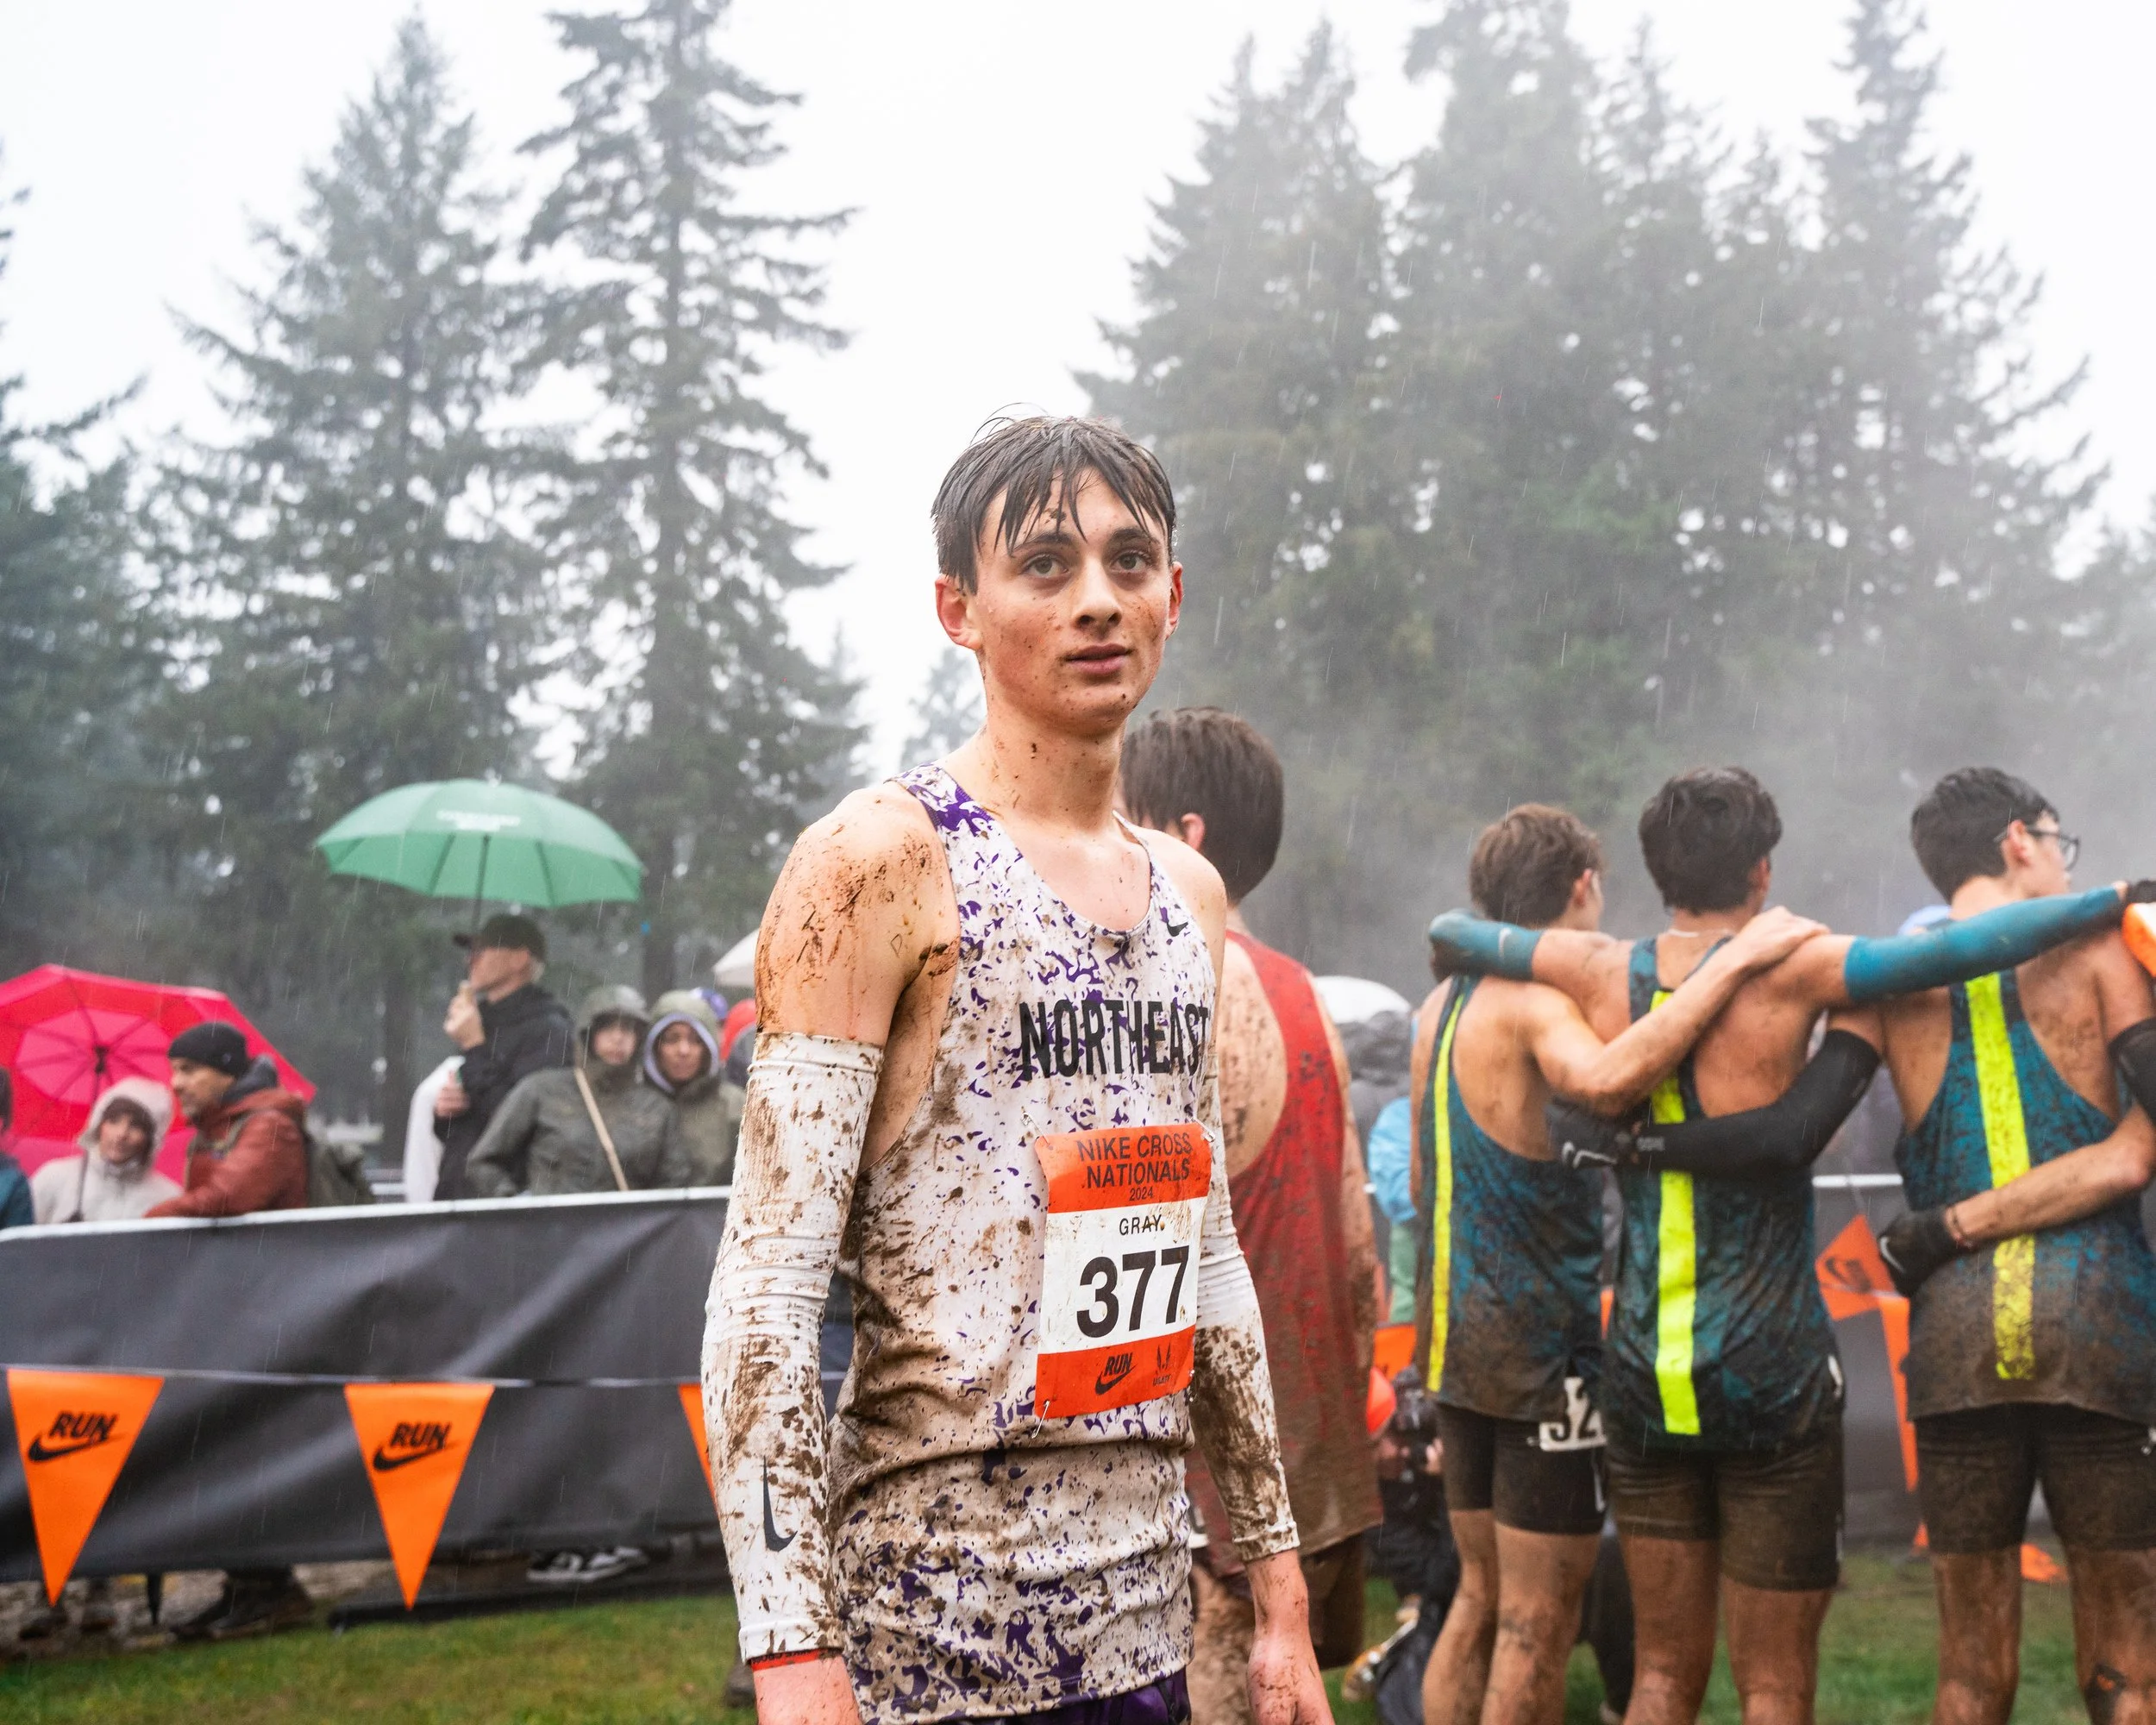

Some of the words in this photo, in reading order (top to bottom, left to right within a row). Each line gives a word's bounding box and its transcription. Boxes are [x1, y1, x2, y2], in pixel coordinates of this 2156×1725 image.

[1019, 999, 1208, 1081] NORTHEAST
[1078, 1136, 1131, 1162] NIKE
[1137, 1132, 1193, 1158] CROSS
[1087, 1158, 1191, 1189] NATIONALS
[1129, 1186, 1154, 1201] 2024
[1119, 1214, 1162, 1236] GRAY
[1076, 1245, 1189, 1338] 377
[1104, 1352, 1133, 1377] RUN
[49, 1411, 118, 1442] RUN
[390, 1421, 451, 1449] RUN
